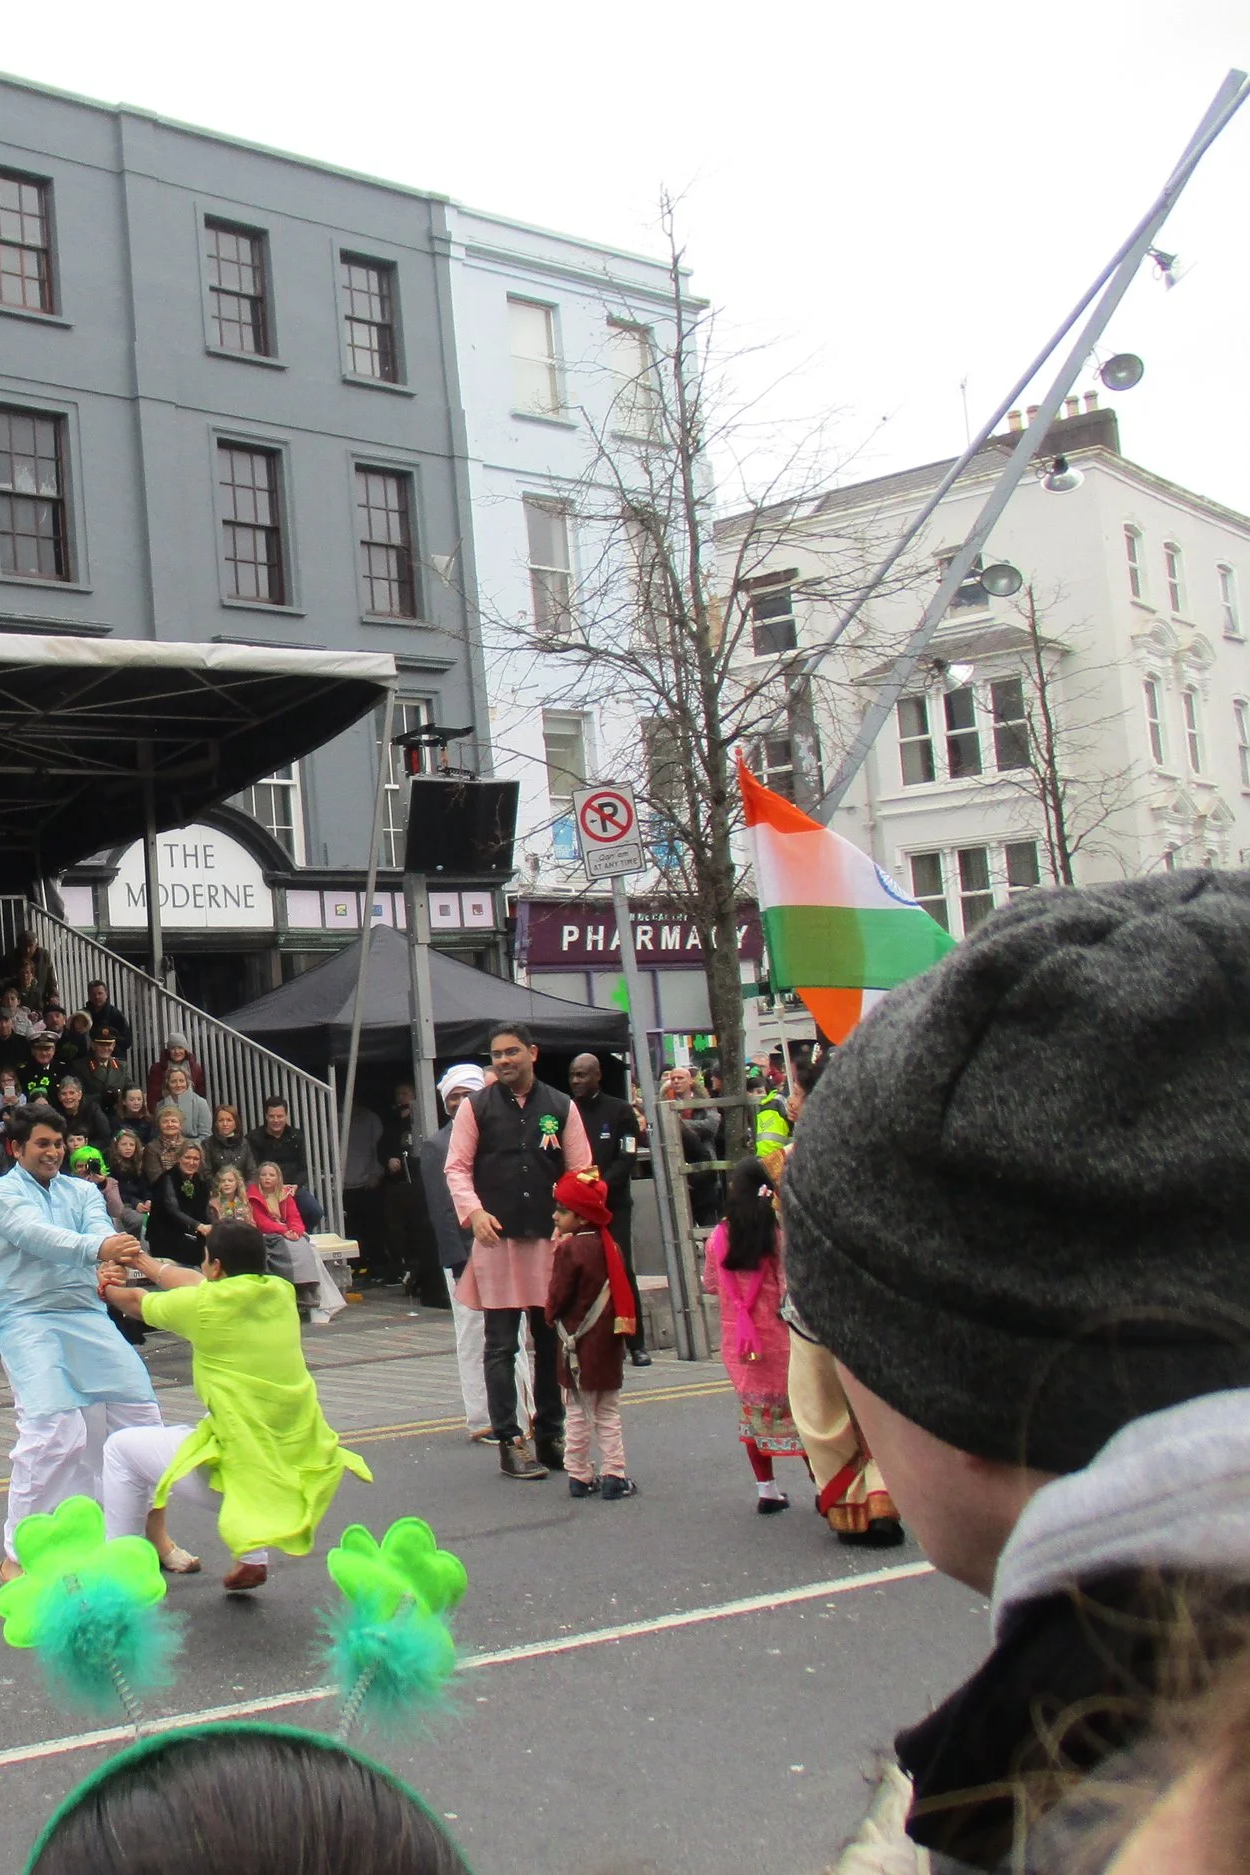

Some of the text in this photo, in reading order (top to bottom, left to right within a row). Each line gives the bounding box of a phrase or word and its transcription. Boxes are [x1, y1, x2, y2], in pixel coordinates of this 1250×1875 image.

[163, 843, 215, 869] THE
[604, 861, 618, 869] ANY
[620, 858, 638, 867] TIME
